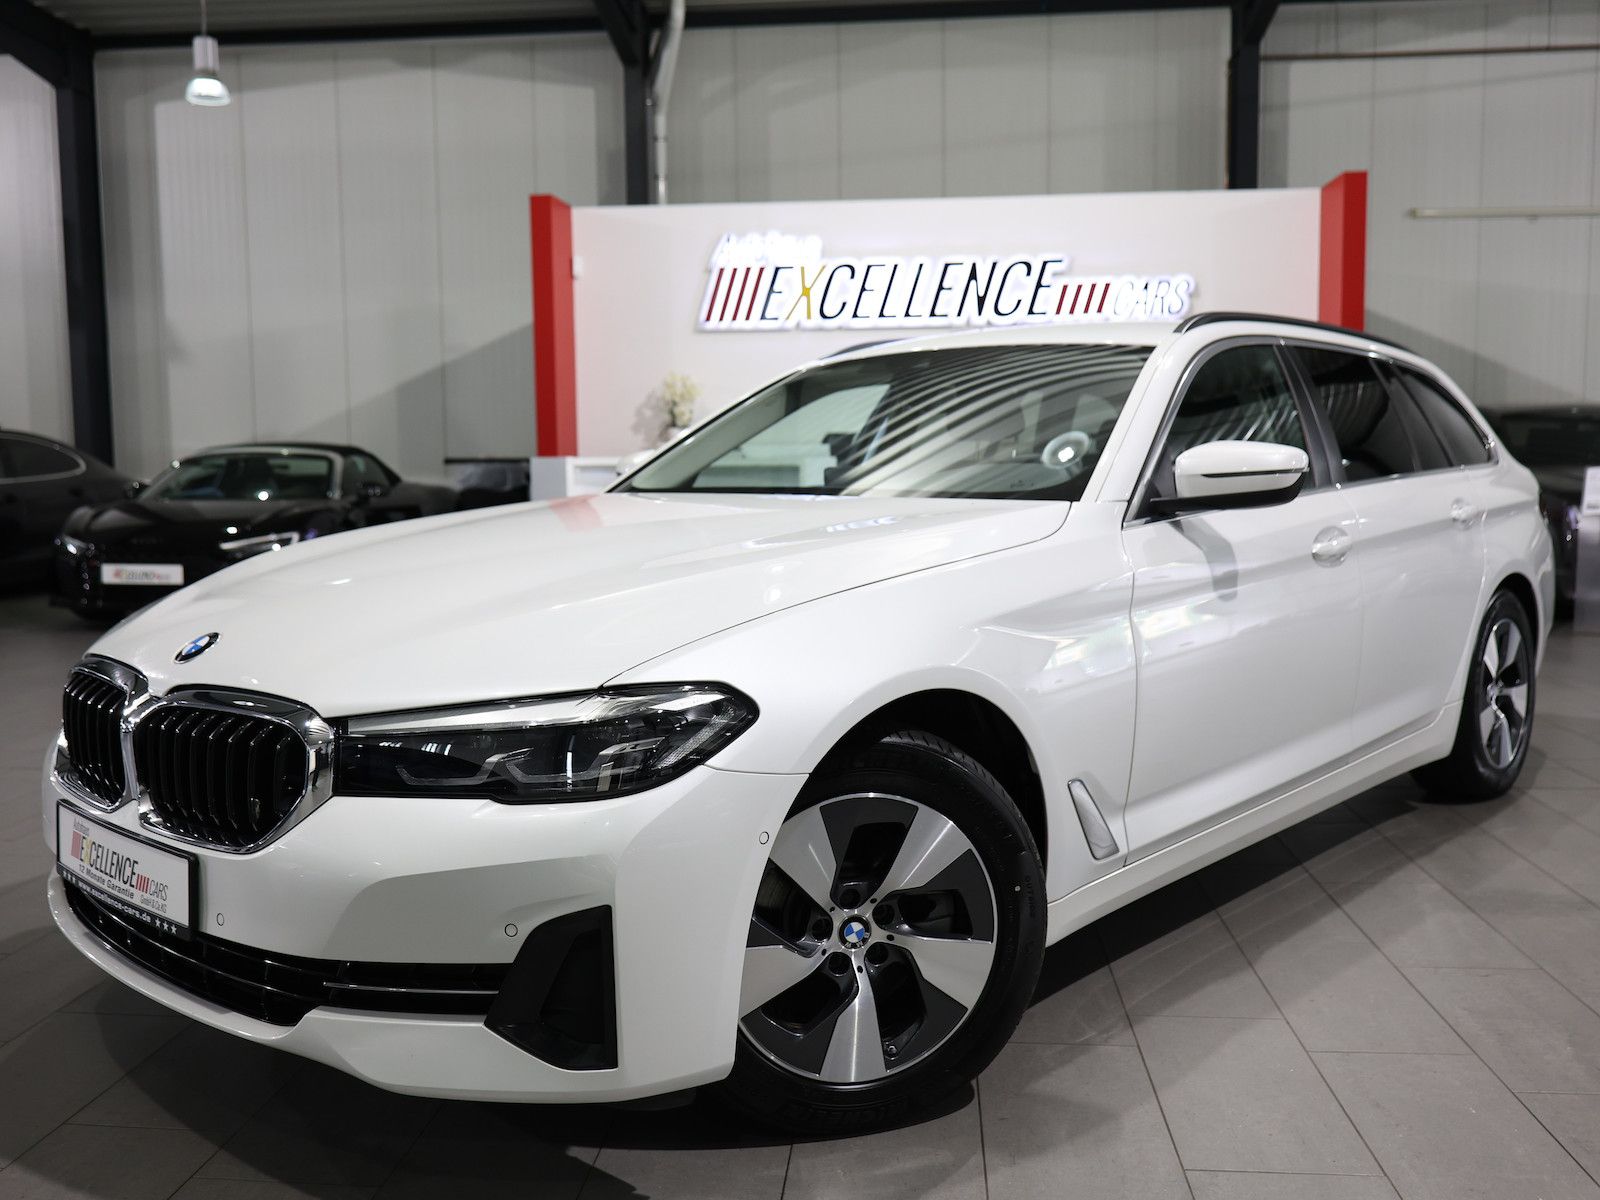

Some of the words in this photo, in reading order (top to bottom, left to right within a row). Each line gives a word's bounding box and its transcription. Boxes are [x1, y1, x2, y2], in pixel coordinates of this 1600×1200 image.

[760, 260, 1063, 321] EXCELLENCE
[1113, 279, 1190, 317] CARS
[79, 836, 138, 888] EXCELLENCE
[149, 879, 168, 902] CARS
[106, 879, 134, 899] Garantie
